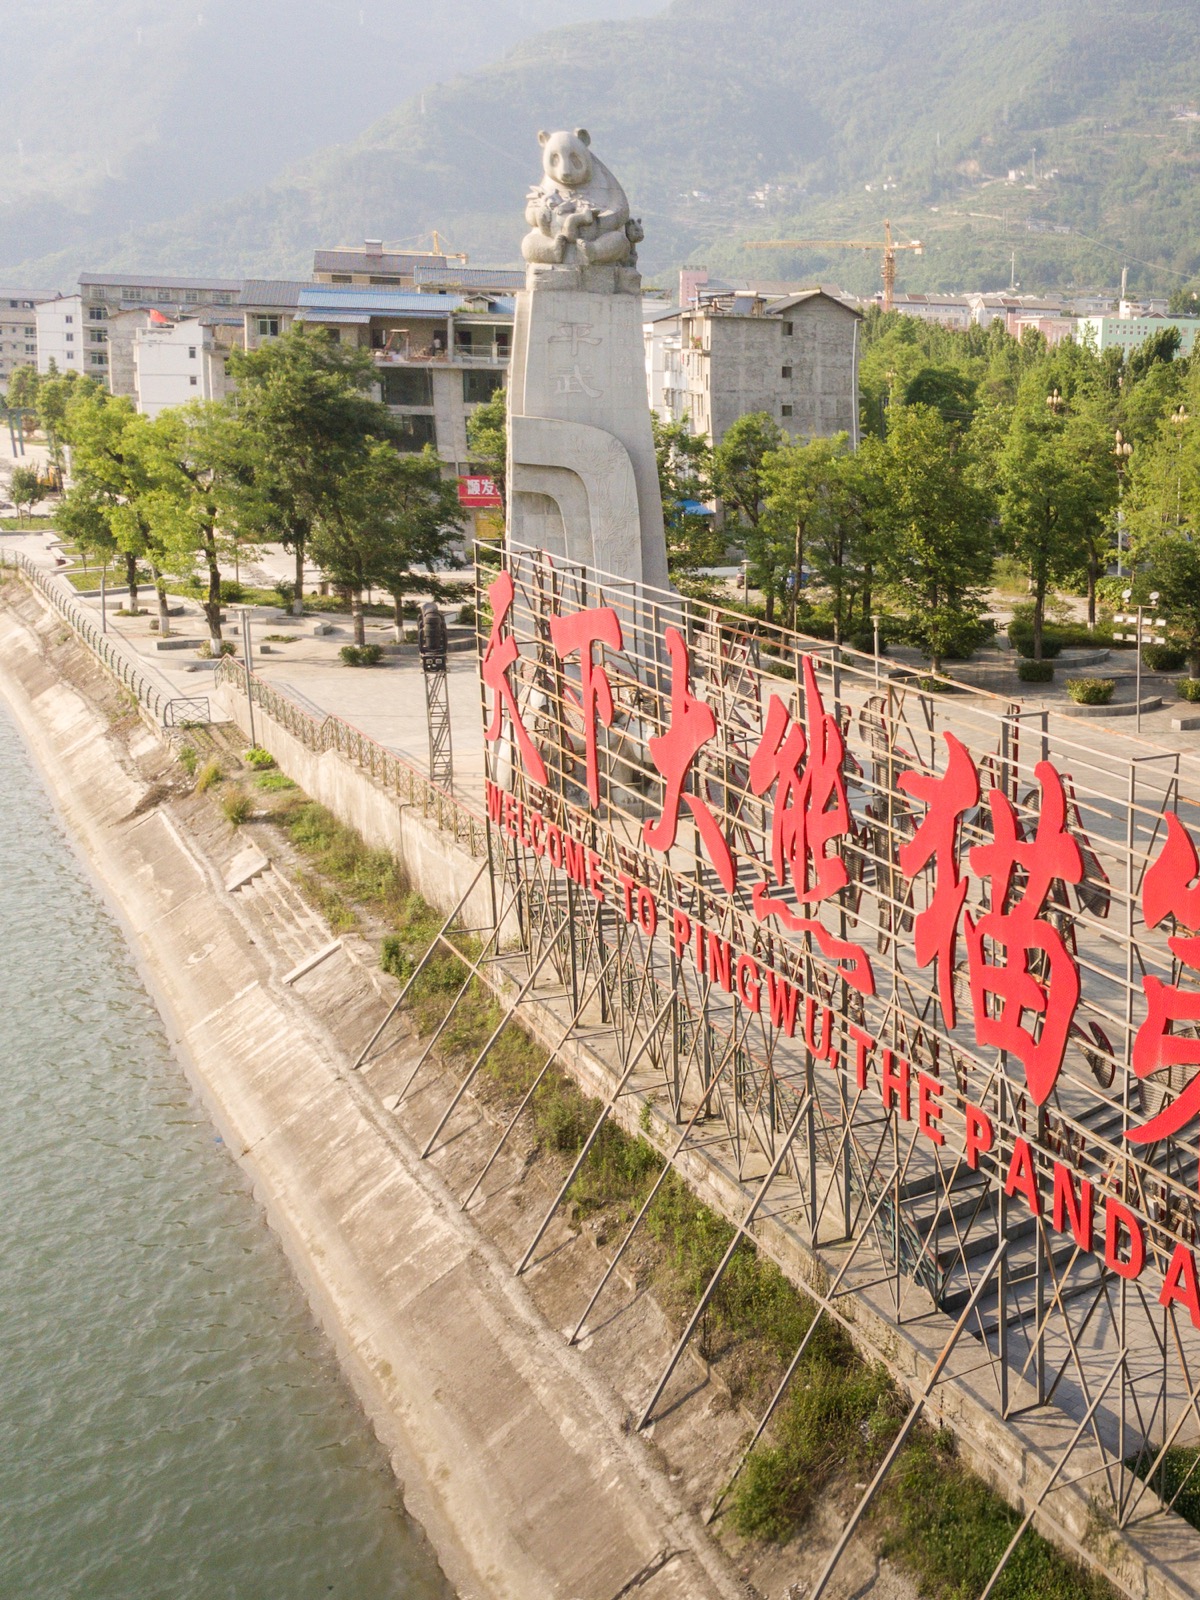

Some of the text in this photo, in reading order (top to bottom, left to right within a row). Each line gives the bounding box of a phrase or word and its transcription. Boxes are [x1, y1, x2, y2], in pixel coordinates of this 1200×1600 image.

[547, 321, 605, 399] 平武
[485, 779, 605, 902] WELCOME
[618, 872, 657, 937] TO
[673, 909, 839, 1069] PINGWU,
[849, 1023, 945, 1147] THE
